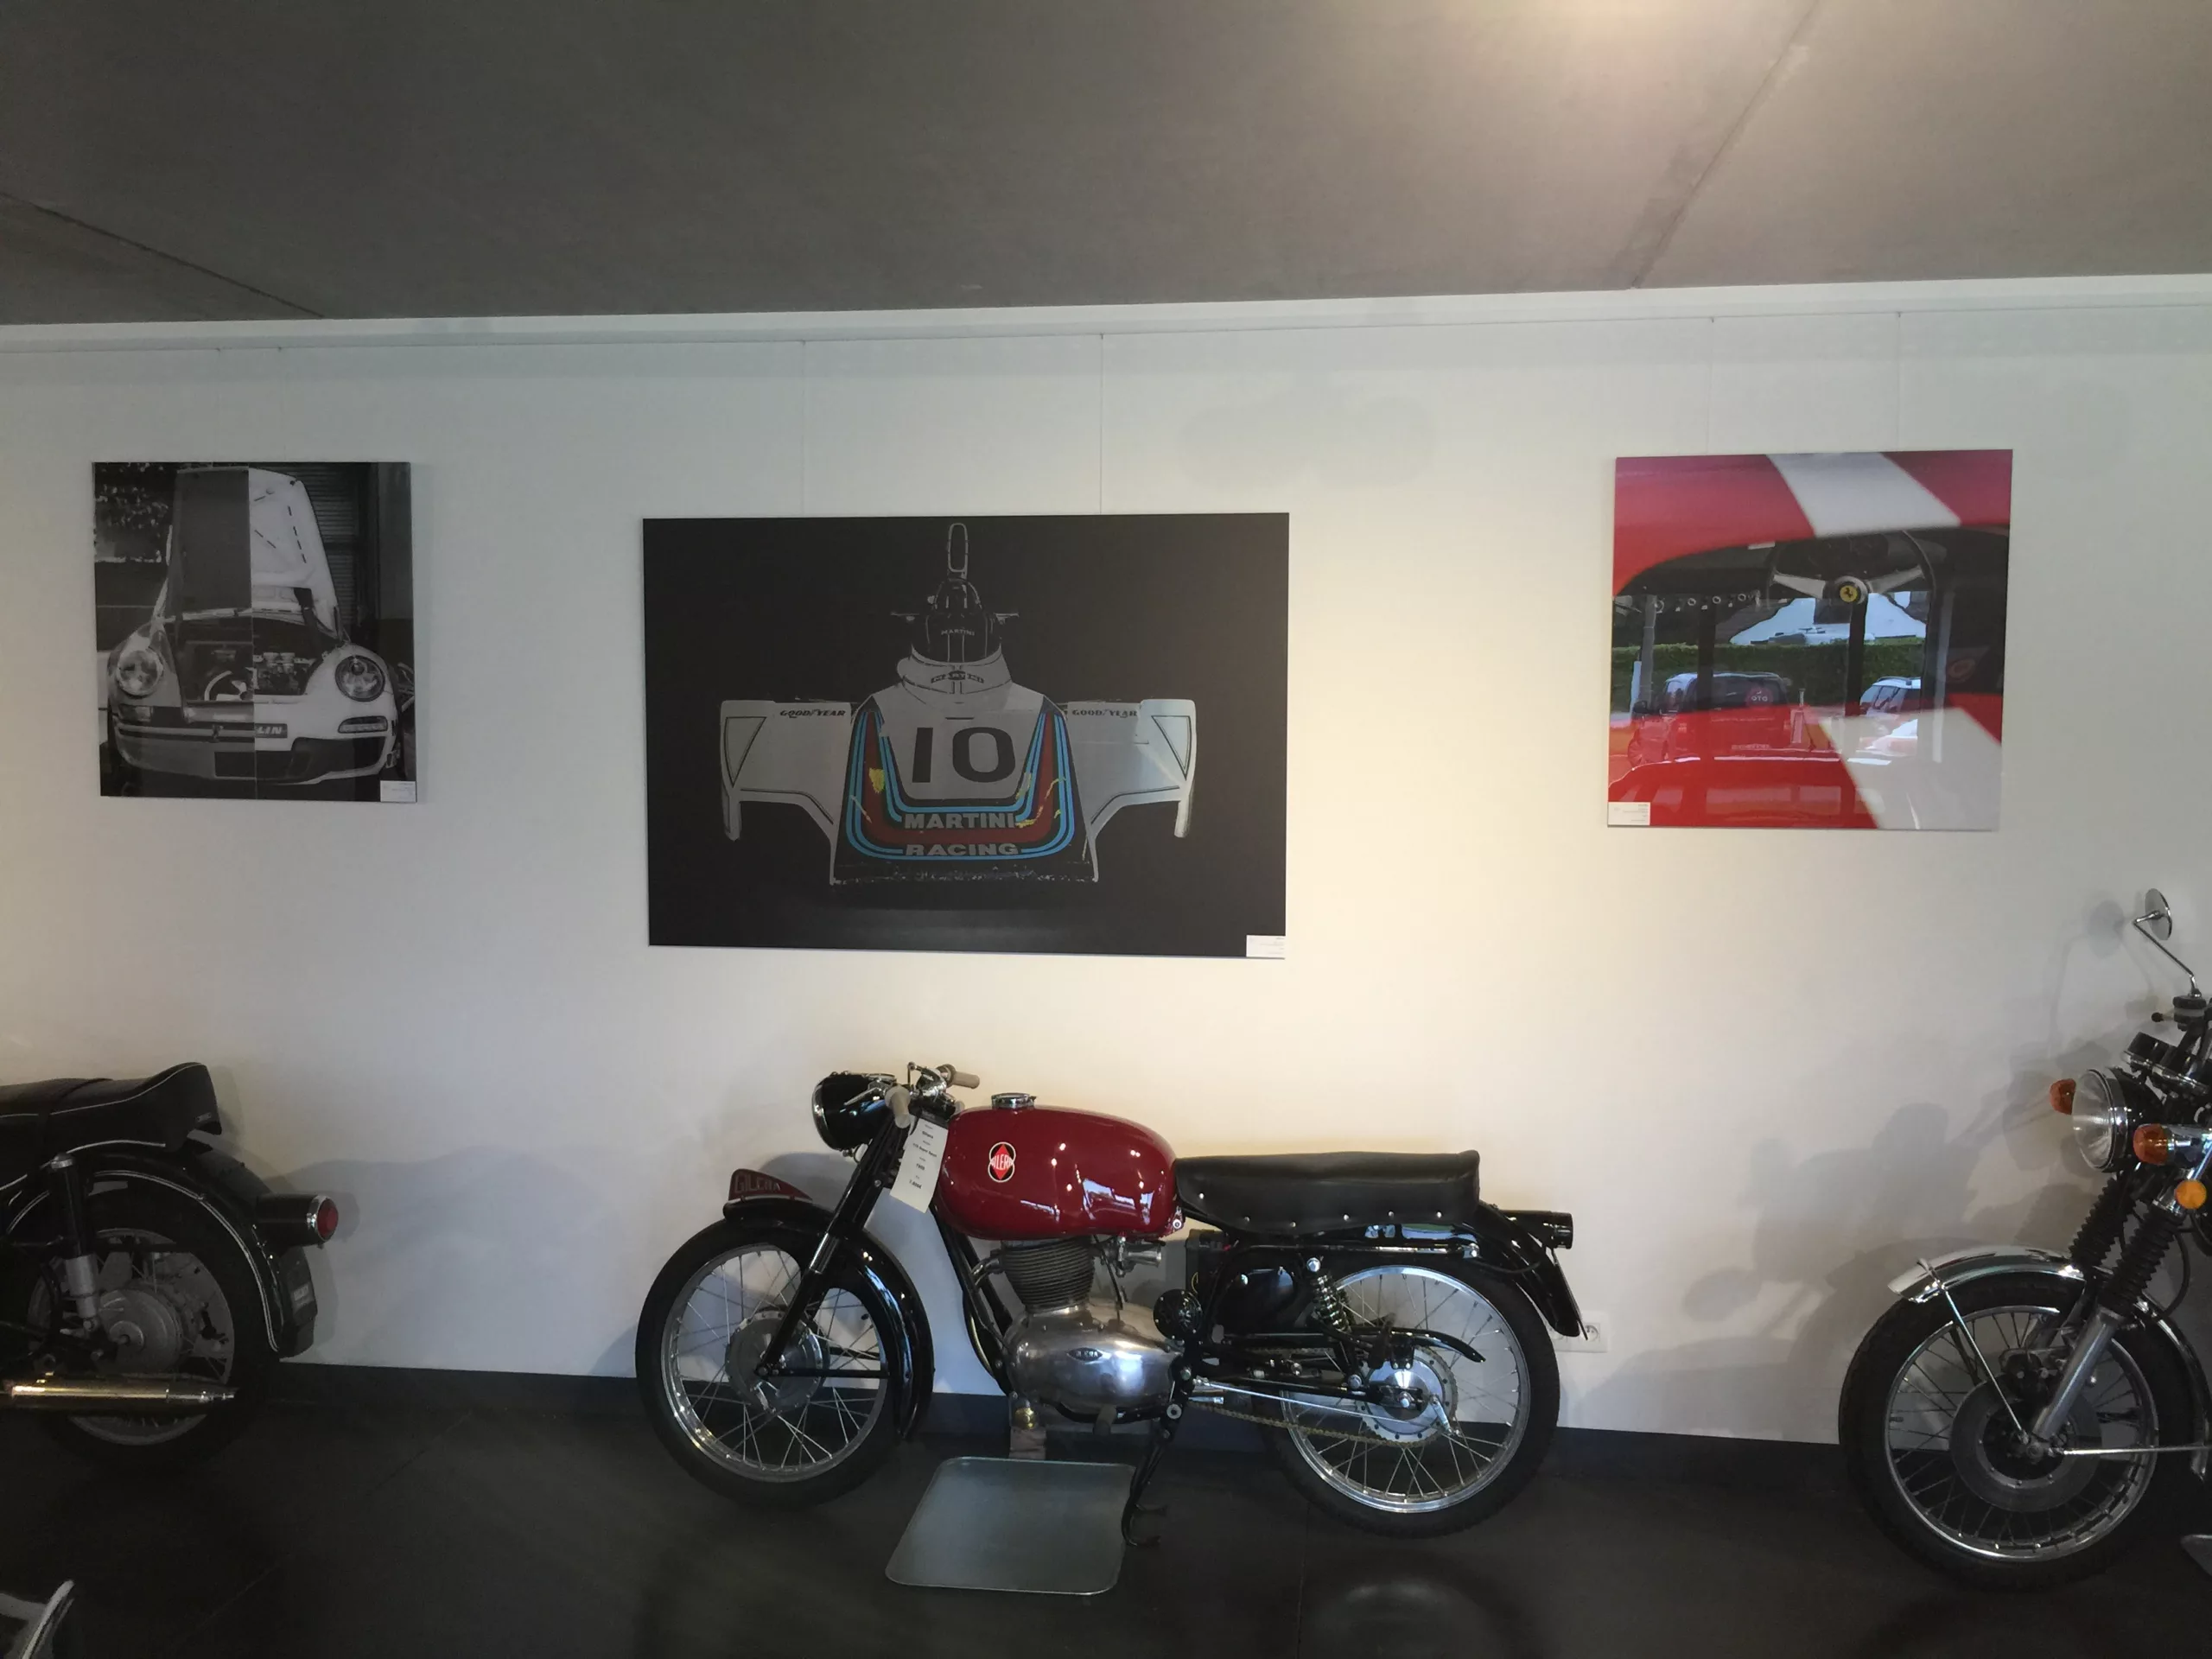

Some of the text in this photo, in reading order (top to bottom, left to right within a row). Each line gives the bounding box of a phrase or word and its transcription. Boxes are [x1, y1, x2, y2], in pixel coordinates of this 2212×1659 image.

[912, 727, 1016, 783] 10
[904, 812, 1015, 829] MARTINI
[906, 842, 1019, 856] RACING
